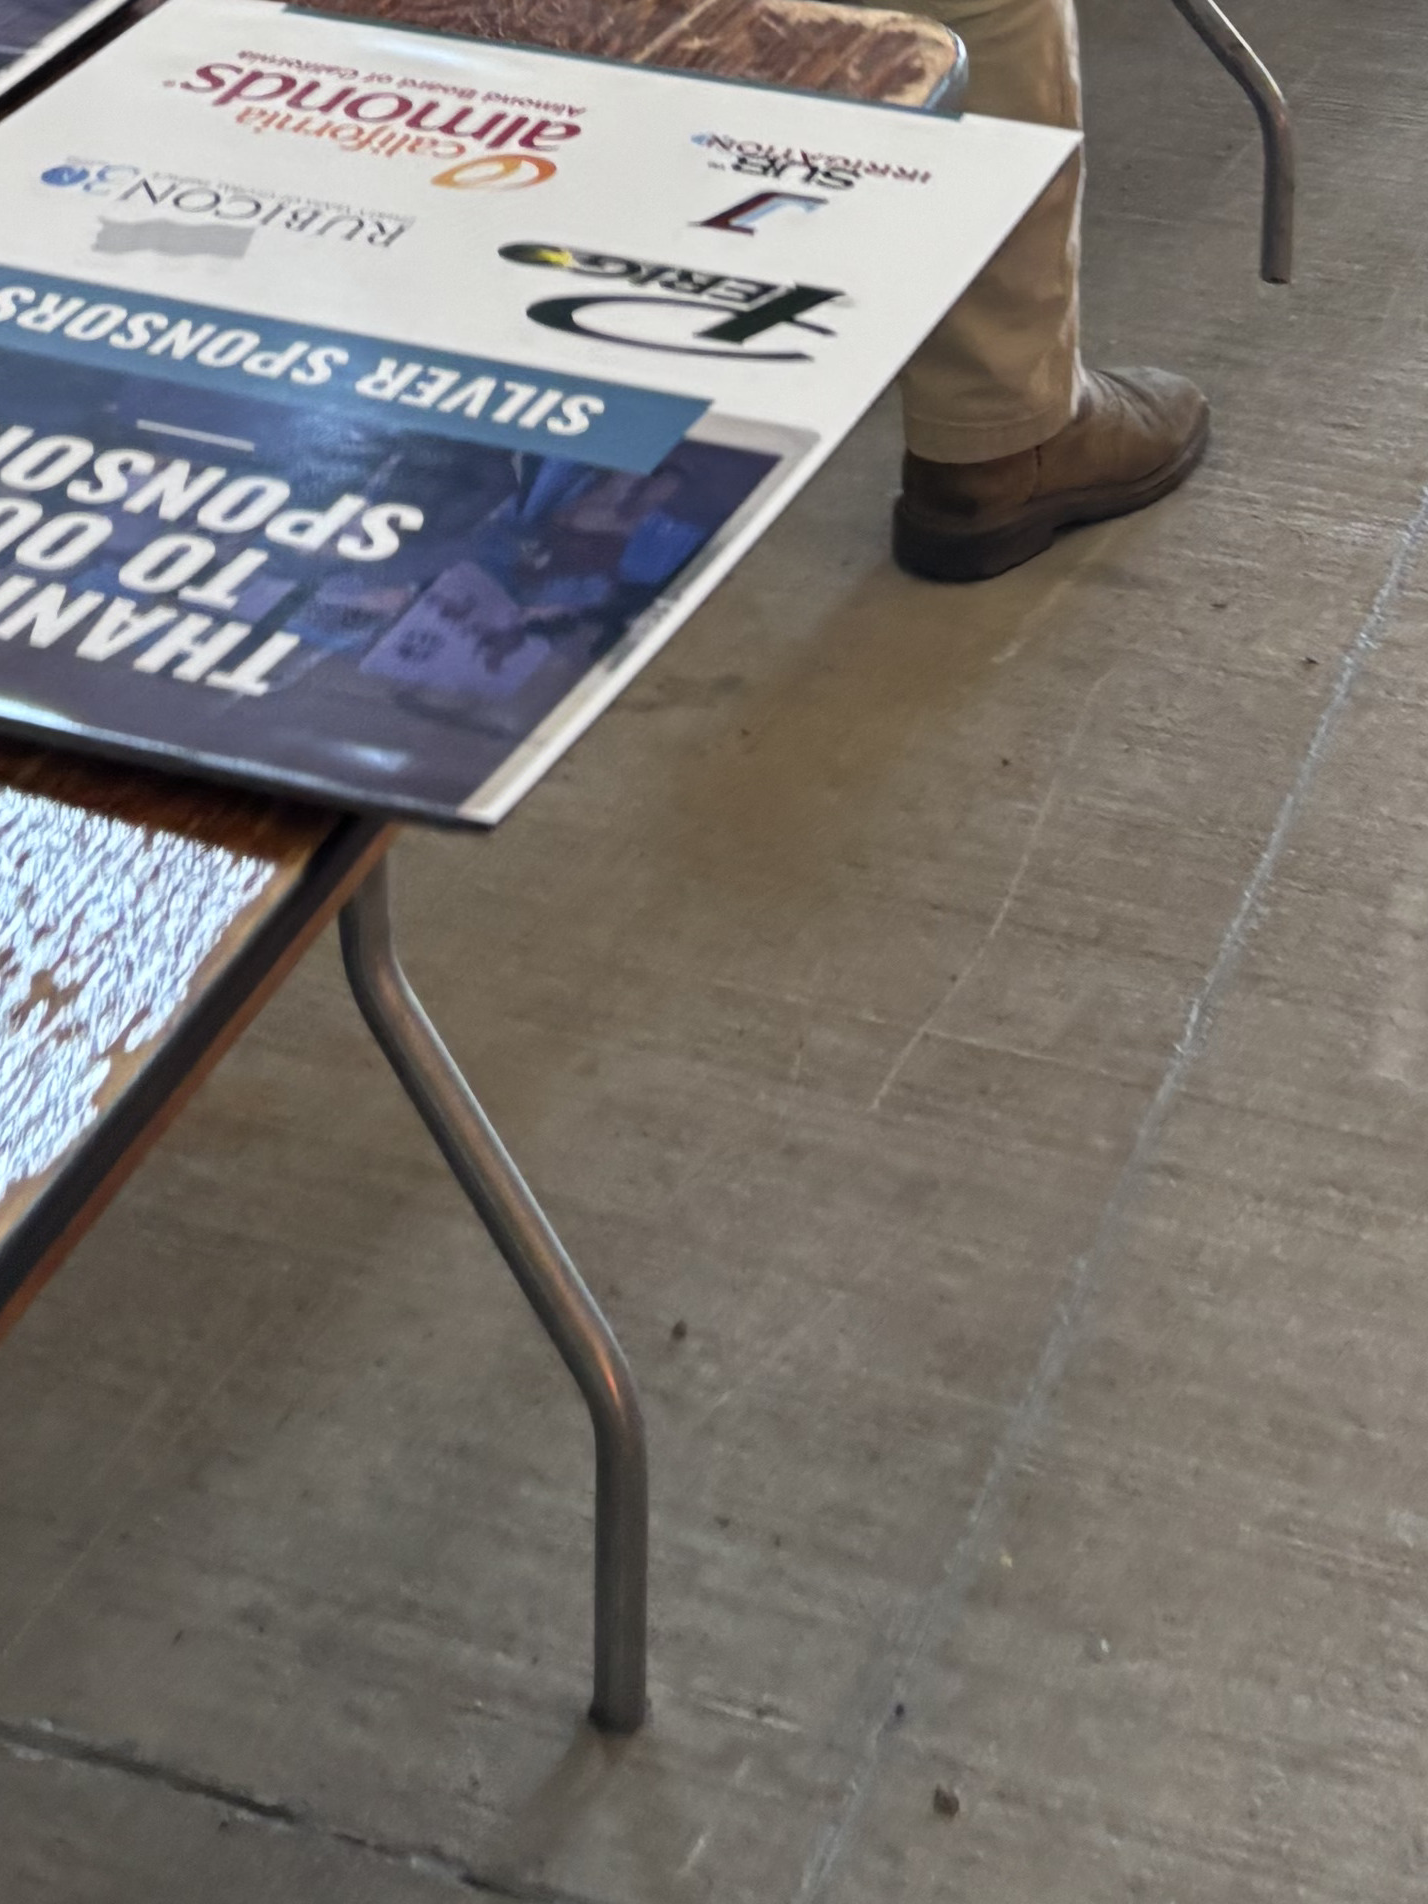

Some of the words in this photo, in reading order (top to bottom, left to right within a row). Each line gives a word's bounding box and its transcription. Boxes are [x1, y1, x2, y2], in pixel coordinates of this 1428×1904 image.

[180, 62, 582, 154] almonds
[234, 106, 467, 162] california
[354, 356, 606, 438] SILVER
[117, 532, 272, 610] TO
